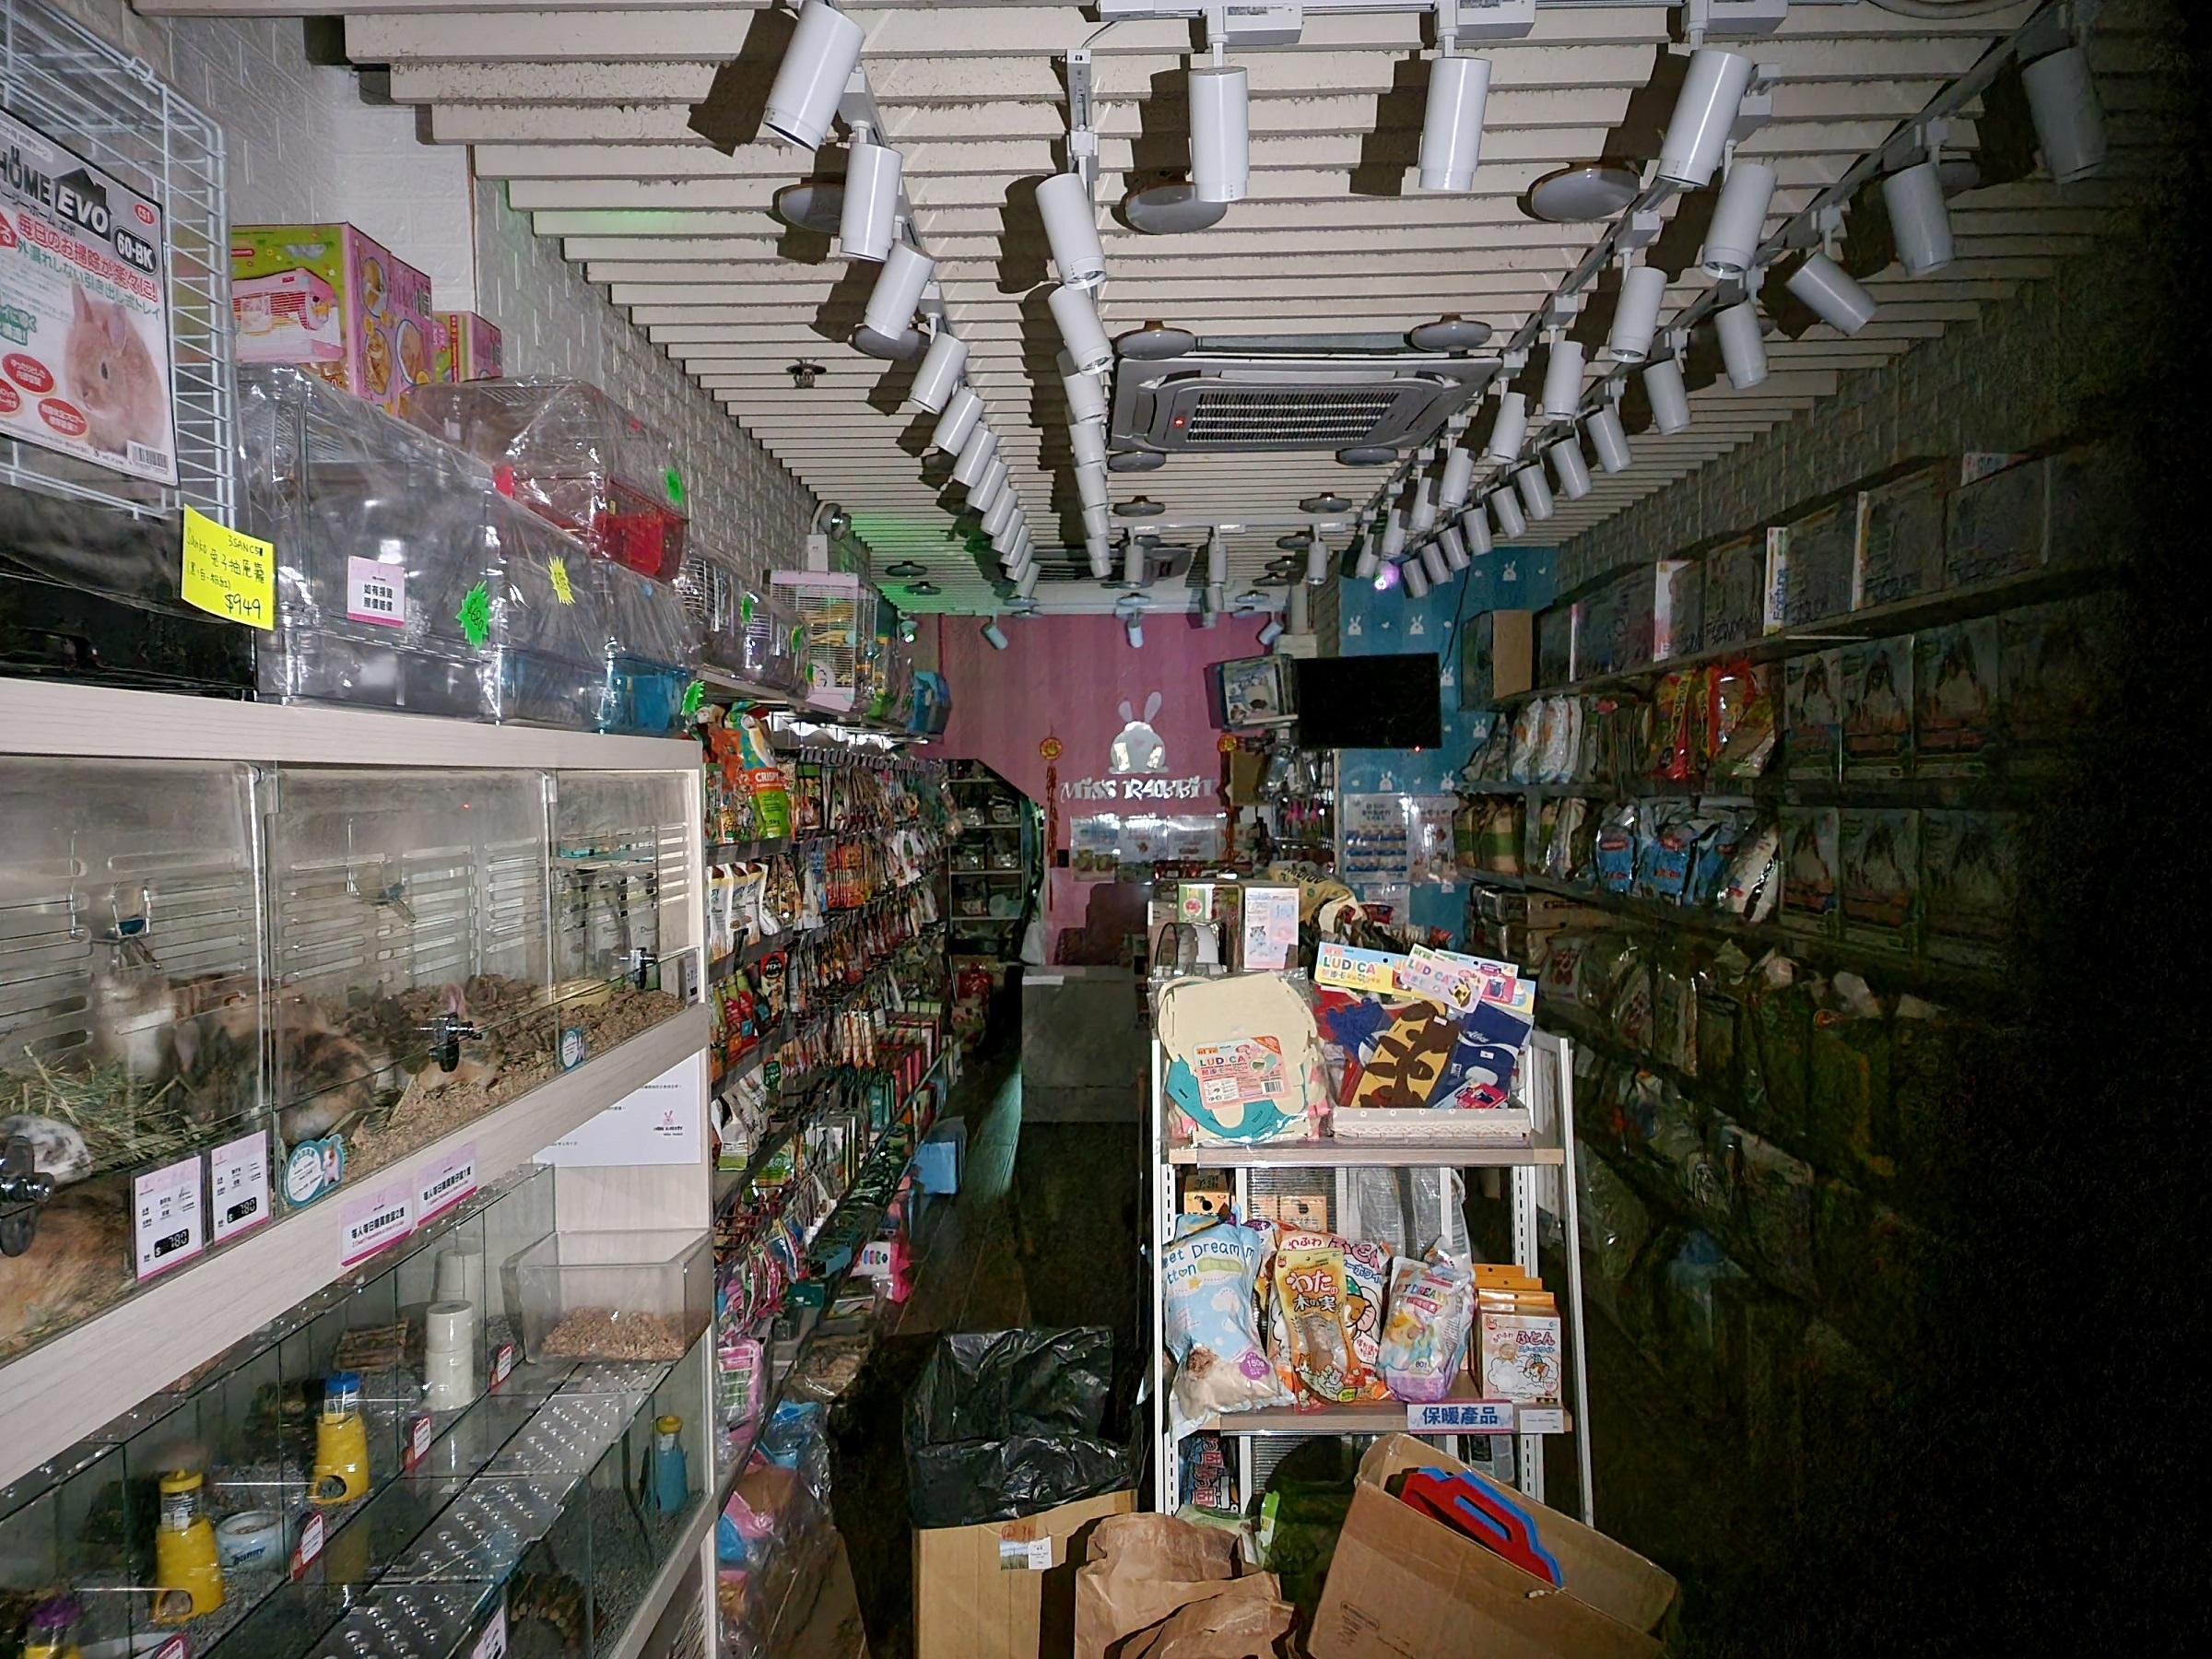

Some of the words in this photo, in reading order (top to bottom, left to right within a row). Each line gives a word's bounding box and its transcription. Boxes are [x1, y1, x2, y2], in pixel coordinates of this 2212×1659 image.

[57, 185, 109, 233] EVO
[116, 233, 154, 271] 60-BK
[224, 594, 261, 620] $949
[1323, 956, 1376, 975] LUDICA
[1199, 1055, 1246, 1066] LUDICA
[1293, 1293, 1337, 1313] 木の実
[1515, 1330, 1556, 1346] ふとん
[1421, 1406, 1499, 1425] 保暖產品
